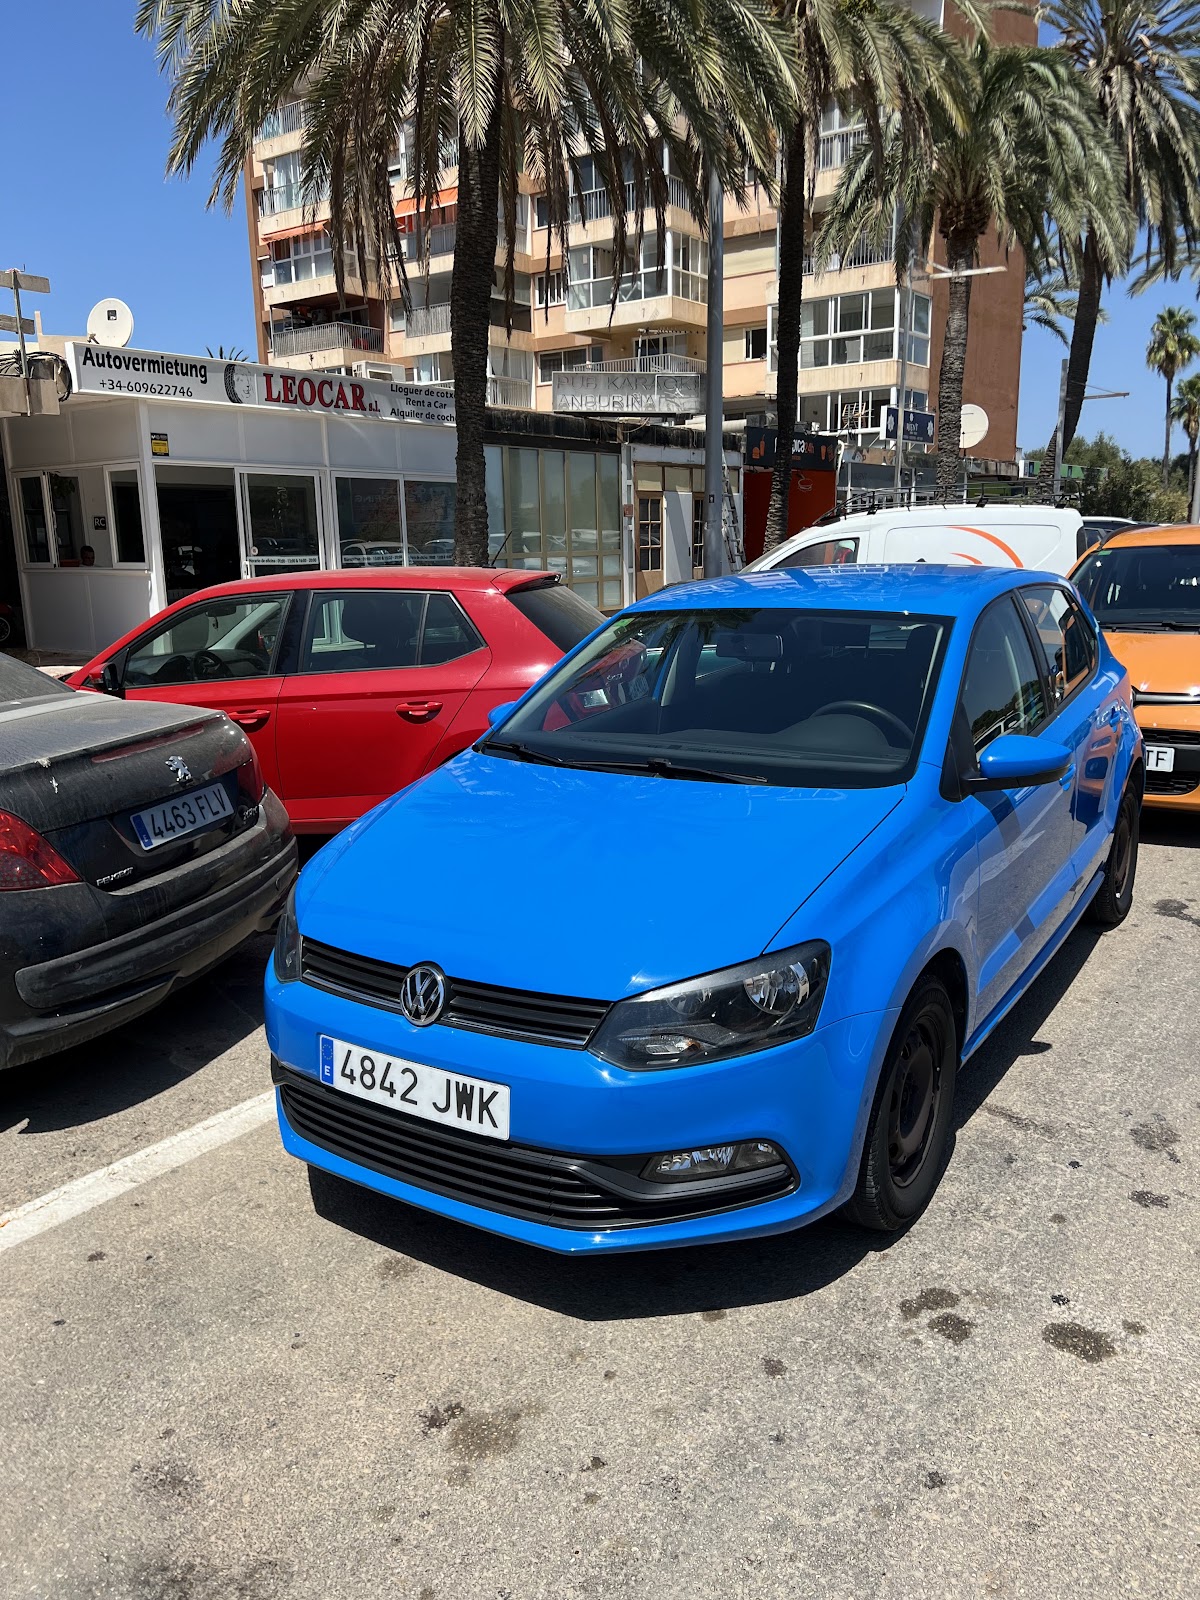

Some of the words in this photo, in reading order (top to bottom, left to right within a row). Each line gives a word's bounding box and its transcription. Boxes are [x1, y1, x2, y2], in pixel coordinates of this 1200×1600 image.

[82, 347, 208, 385] Autovermietung
[99, 379, 193, 397] +34-609622746
[390, 383, 423, 396] Lloguer
[424, 388, 435, 397] de
[436, 391, 455, 399] cotx
[557, 376, 597, 390] PUB
[263, 372, 366, 411] LEOCAR
[405, 397, 426, 407] Rent
[433, 400, 447, 410] Car
[390, 407, 423, 419] Alquiler
[425, 411, 436, 420] de
[436, 413, 455, 422] coch
[94, 518, 105, 526] RC
[151, 801, 197, 838] 4463
[195, 788, 227, 820] FLV
[324, 1065, 331, 1077] E
[341, 1050, 418, 1106] 4842
[432, 1078, 499, 1129] JWK
